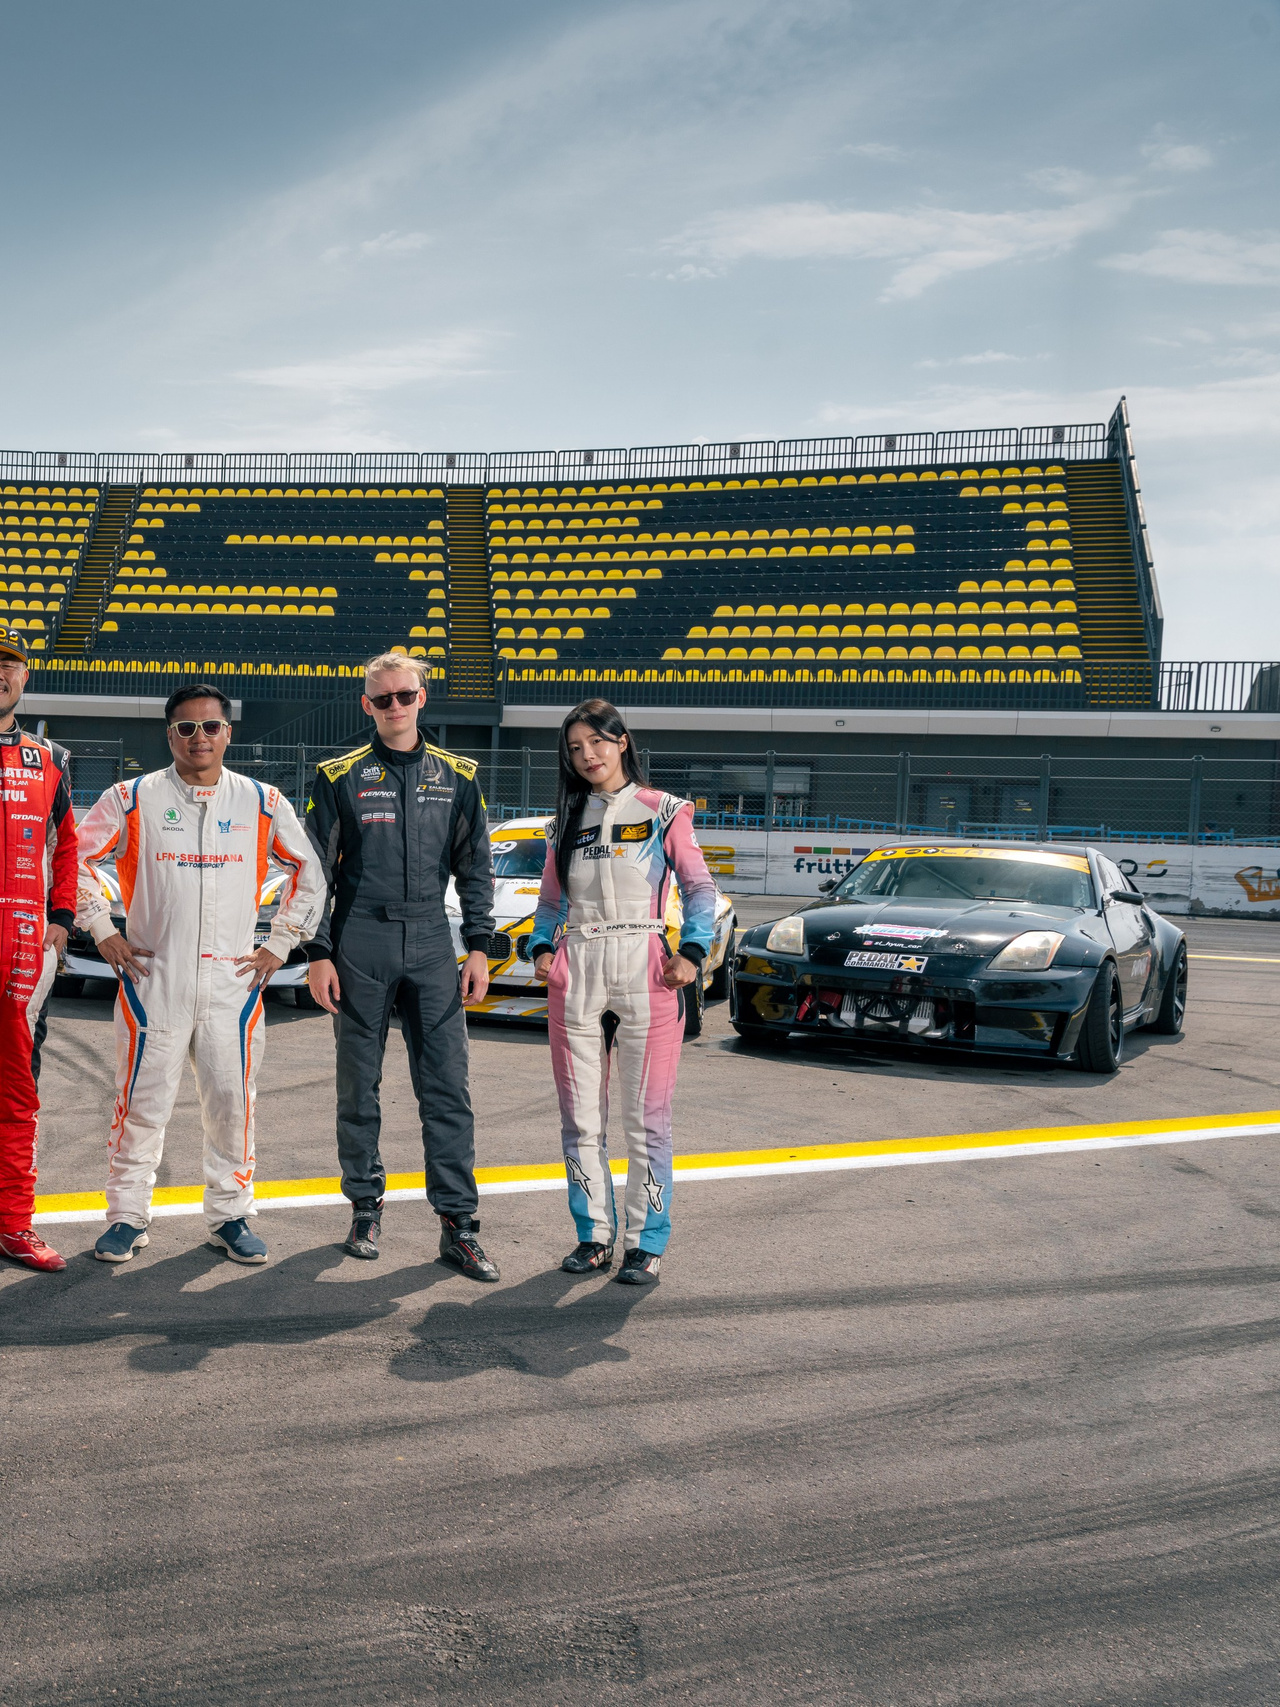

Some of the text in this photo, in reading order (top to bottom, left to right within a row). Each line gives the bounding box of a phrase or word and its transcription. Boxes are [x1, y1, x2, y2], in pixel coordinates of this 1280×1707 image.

[22, 747, 41, 763] D1
[328, 764, 346, 775] OMP
[456, 761, 474, 772] OMP
[119, 783, 130, 800] RX
[583, 844, 611, 856] PEDAL
[156, 852, 244, 863] LFN-SEDERHANA
[177, 861, 226, 869] MOTORSPORT
[793, 857, 855, 875] frütt
[847, 951, 899, 963] PEDAL
[844, 960, 897, 969] COMMANDER
